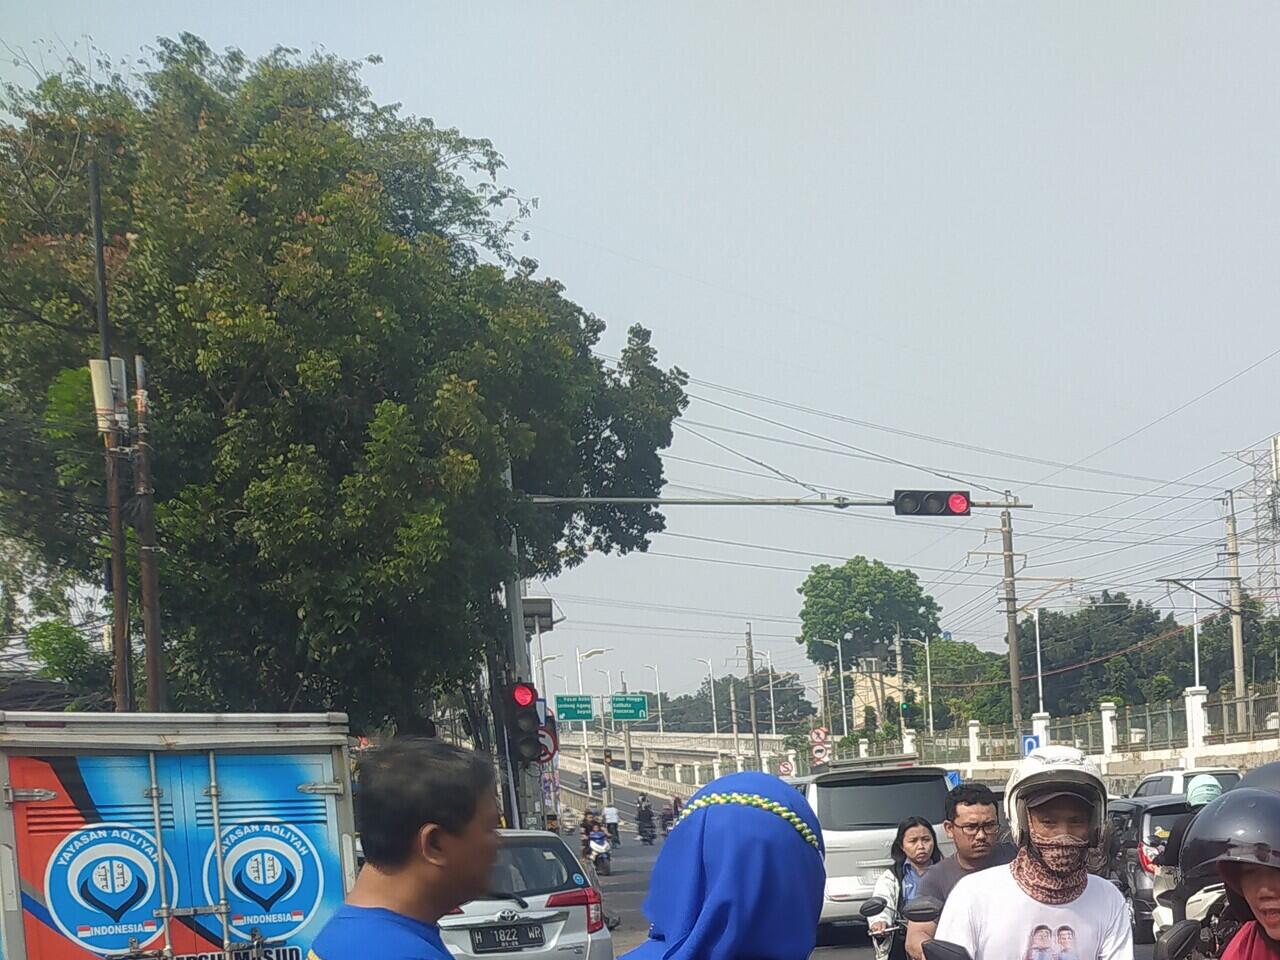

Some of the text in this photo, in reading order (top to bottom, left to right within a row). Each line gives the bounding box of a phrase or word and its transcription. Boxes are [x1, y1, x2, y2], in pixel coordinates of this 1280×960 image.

[57, 829, 160, 866] YAYASAN AQLIYAH
[263, 824, 309, 856] AQLIYAH
[243, 912, 292, 925] INDONESIA
[90, 924, 144, 936] INDONESIA
[475, 931, 483, 943] H
[494, 928, 518, 942] 1822
